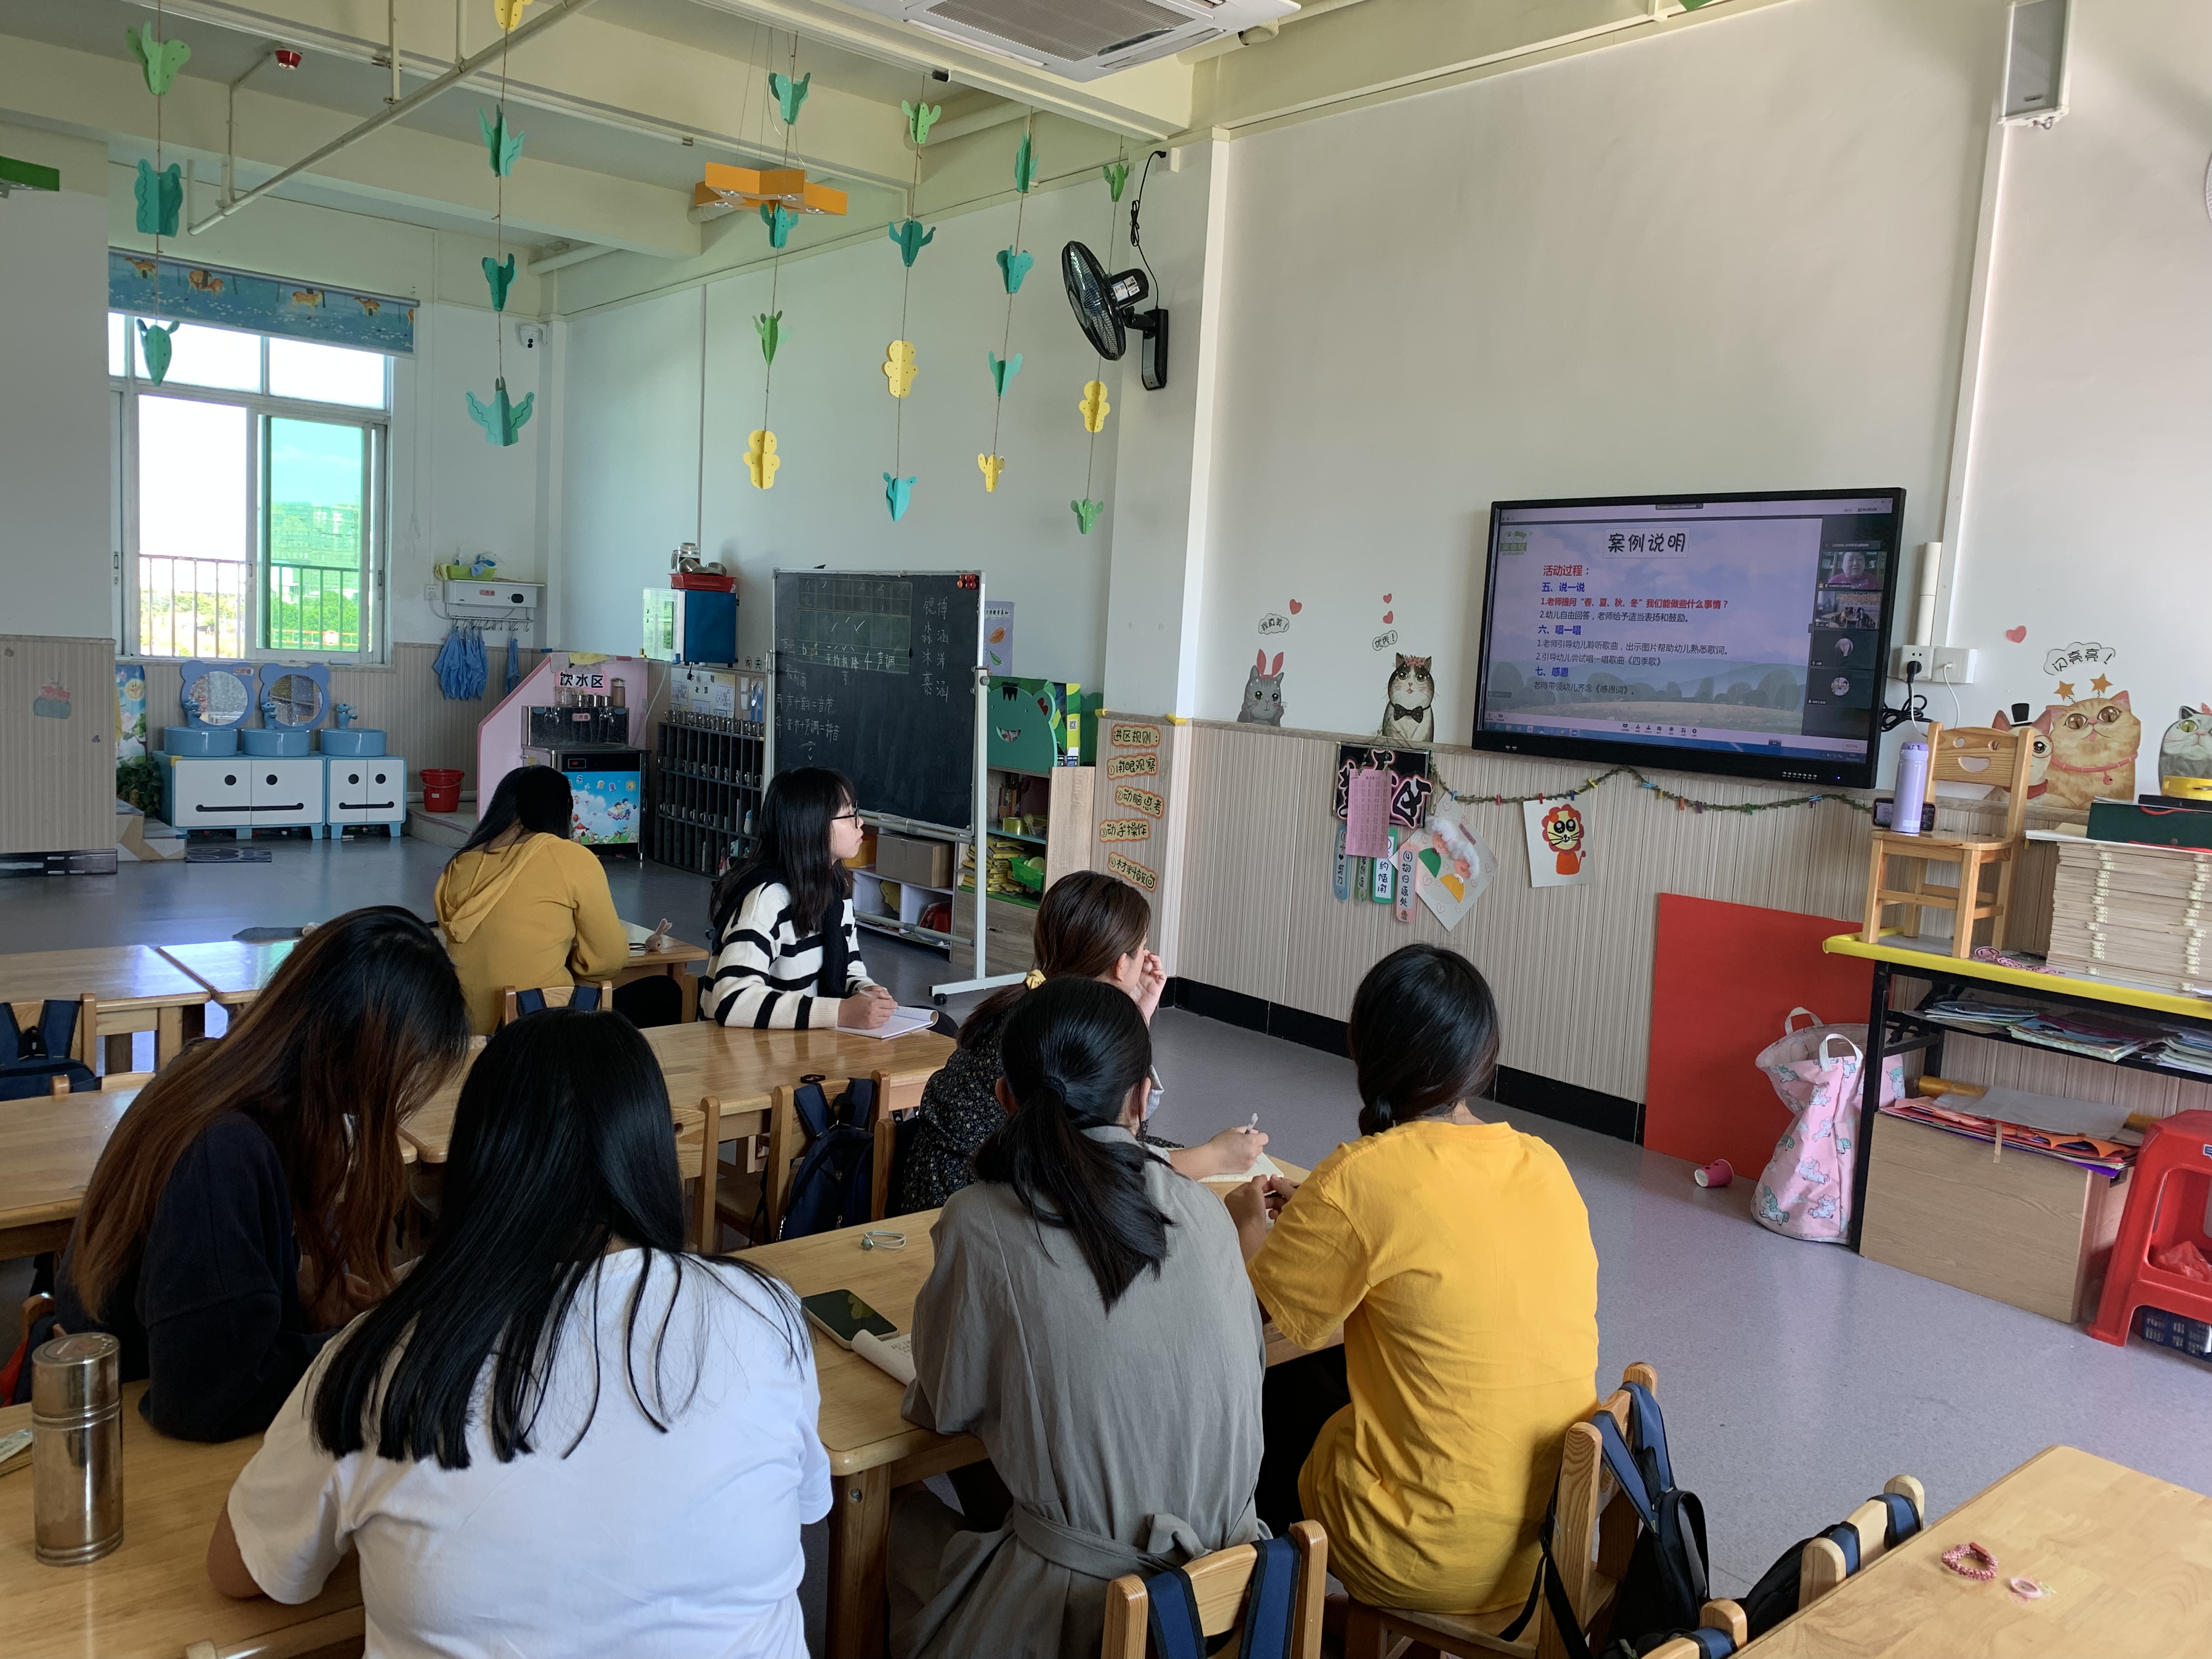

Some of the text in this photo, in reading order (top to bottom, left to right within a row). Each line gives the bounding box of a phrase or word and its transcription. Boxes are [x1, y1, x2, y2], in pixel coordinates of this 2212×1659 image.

[1608, 533, 1685, 552] 案例说明
[1543, 565, 1589, 577] 活动过程：
[1541, 582, 1585, 592] 五、说一说
[1539, 611, 1689, 623] 2.幼儿自由回答，老师给予适当表扬和鼓励。
[1261, 618, 1288, 631] 我真美！
[1538, 625, 1582, 635] 六、唱一唱
[1375, 633, 1395, 648] 优秀！
[1536, 652, 1662, 667] 2.引导幼儿尝试唱一唱歌曲《四季歌》
[2052, 648, 2112, 672] 闪亮亮！
[1536, 667, 1568, 678] 七、感恩
[560, 672, 603, 688] 饮水区
[1533, 681, 1634, 695] 老师带领幼儿齐念《感恩词》。
[1113, 730, 1158, 744] 进区规则：
